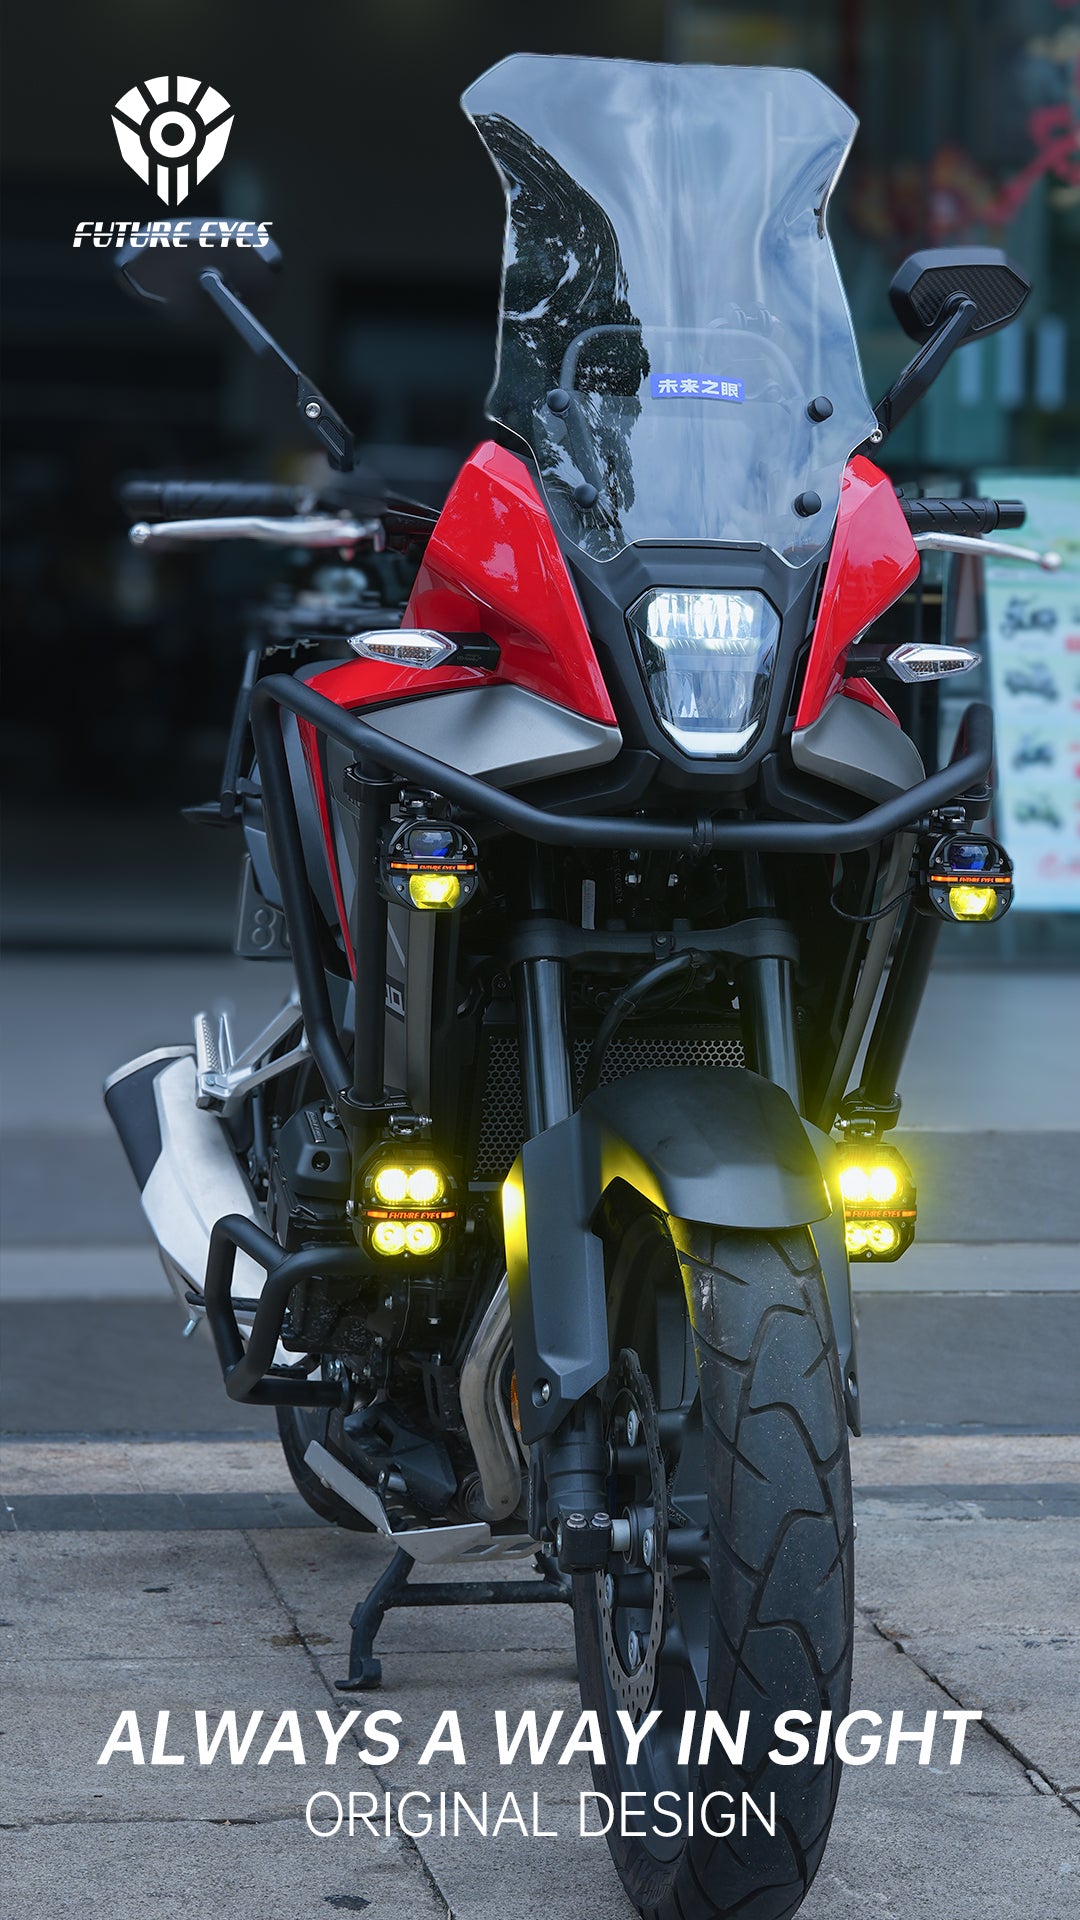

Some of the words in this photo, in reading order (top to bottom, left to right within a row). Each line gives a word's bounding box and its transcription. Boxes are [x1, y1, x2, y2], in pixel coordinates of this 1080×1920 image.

[657, 378, 739, 398] 未来之眼
[388, 1211, 420, 1219] FUTURE
[420, 1211, 441, 1219] EYES
